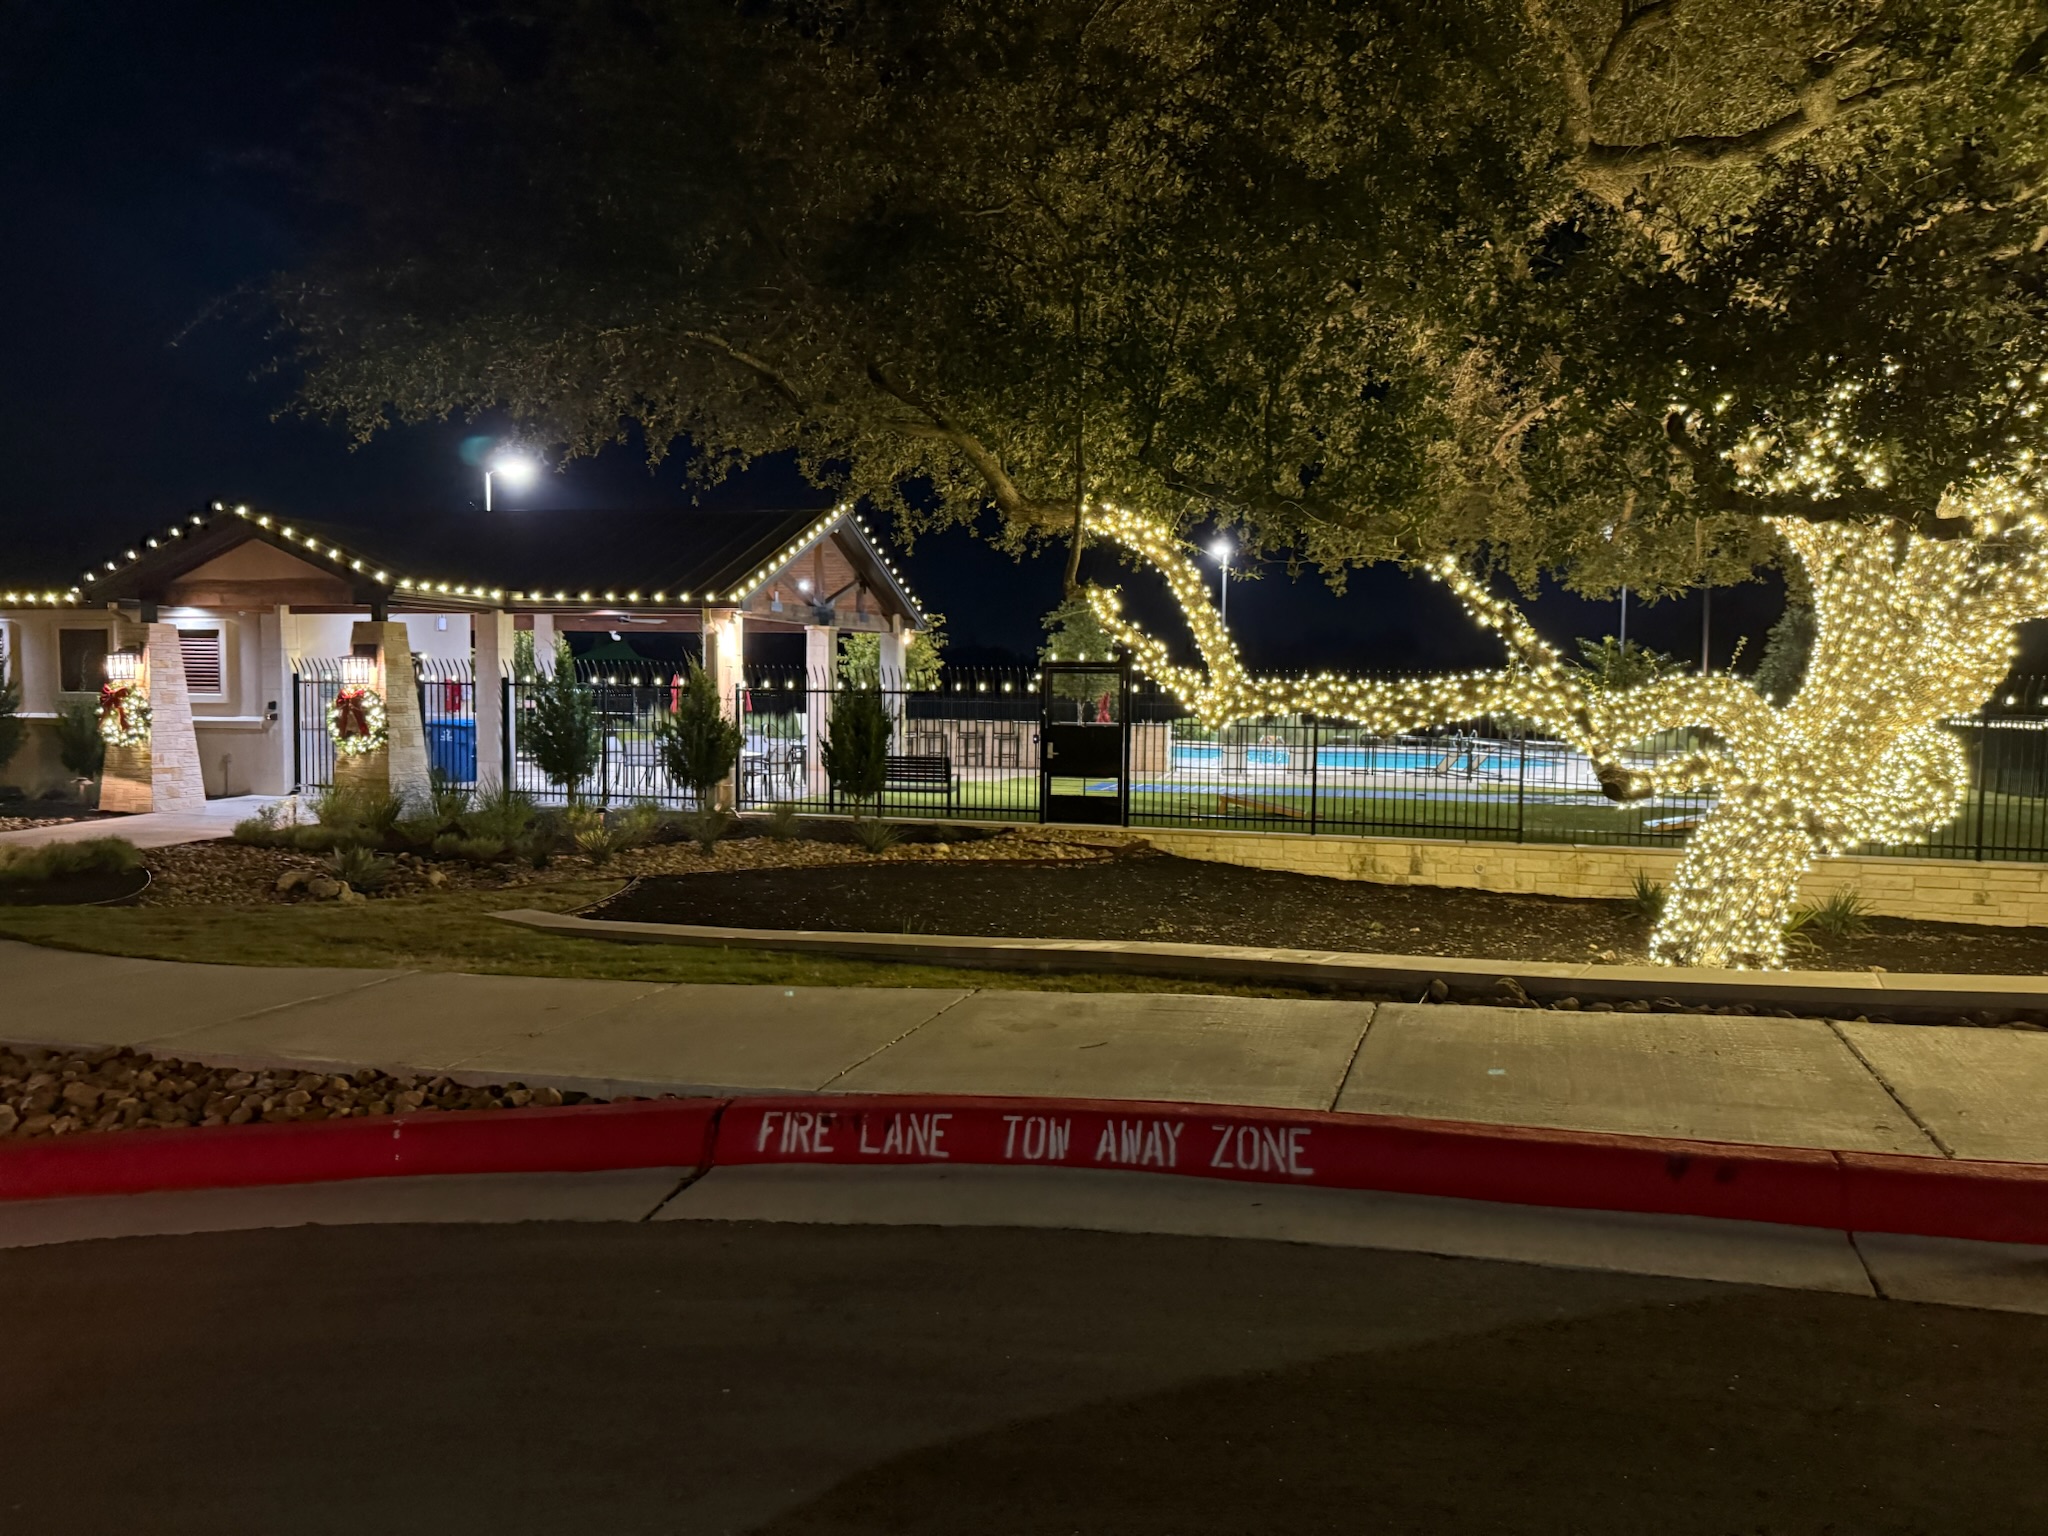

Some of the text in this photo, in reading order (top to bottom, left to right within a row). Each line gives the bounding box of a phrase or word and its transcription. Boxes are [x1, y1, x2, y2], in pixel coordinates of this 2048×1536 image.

[757, 1112, 1314, 1175] FIRE LANE TOW AWAY ZONE
